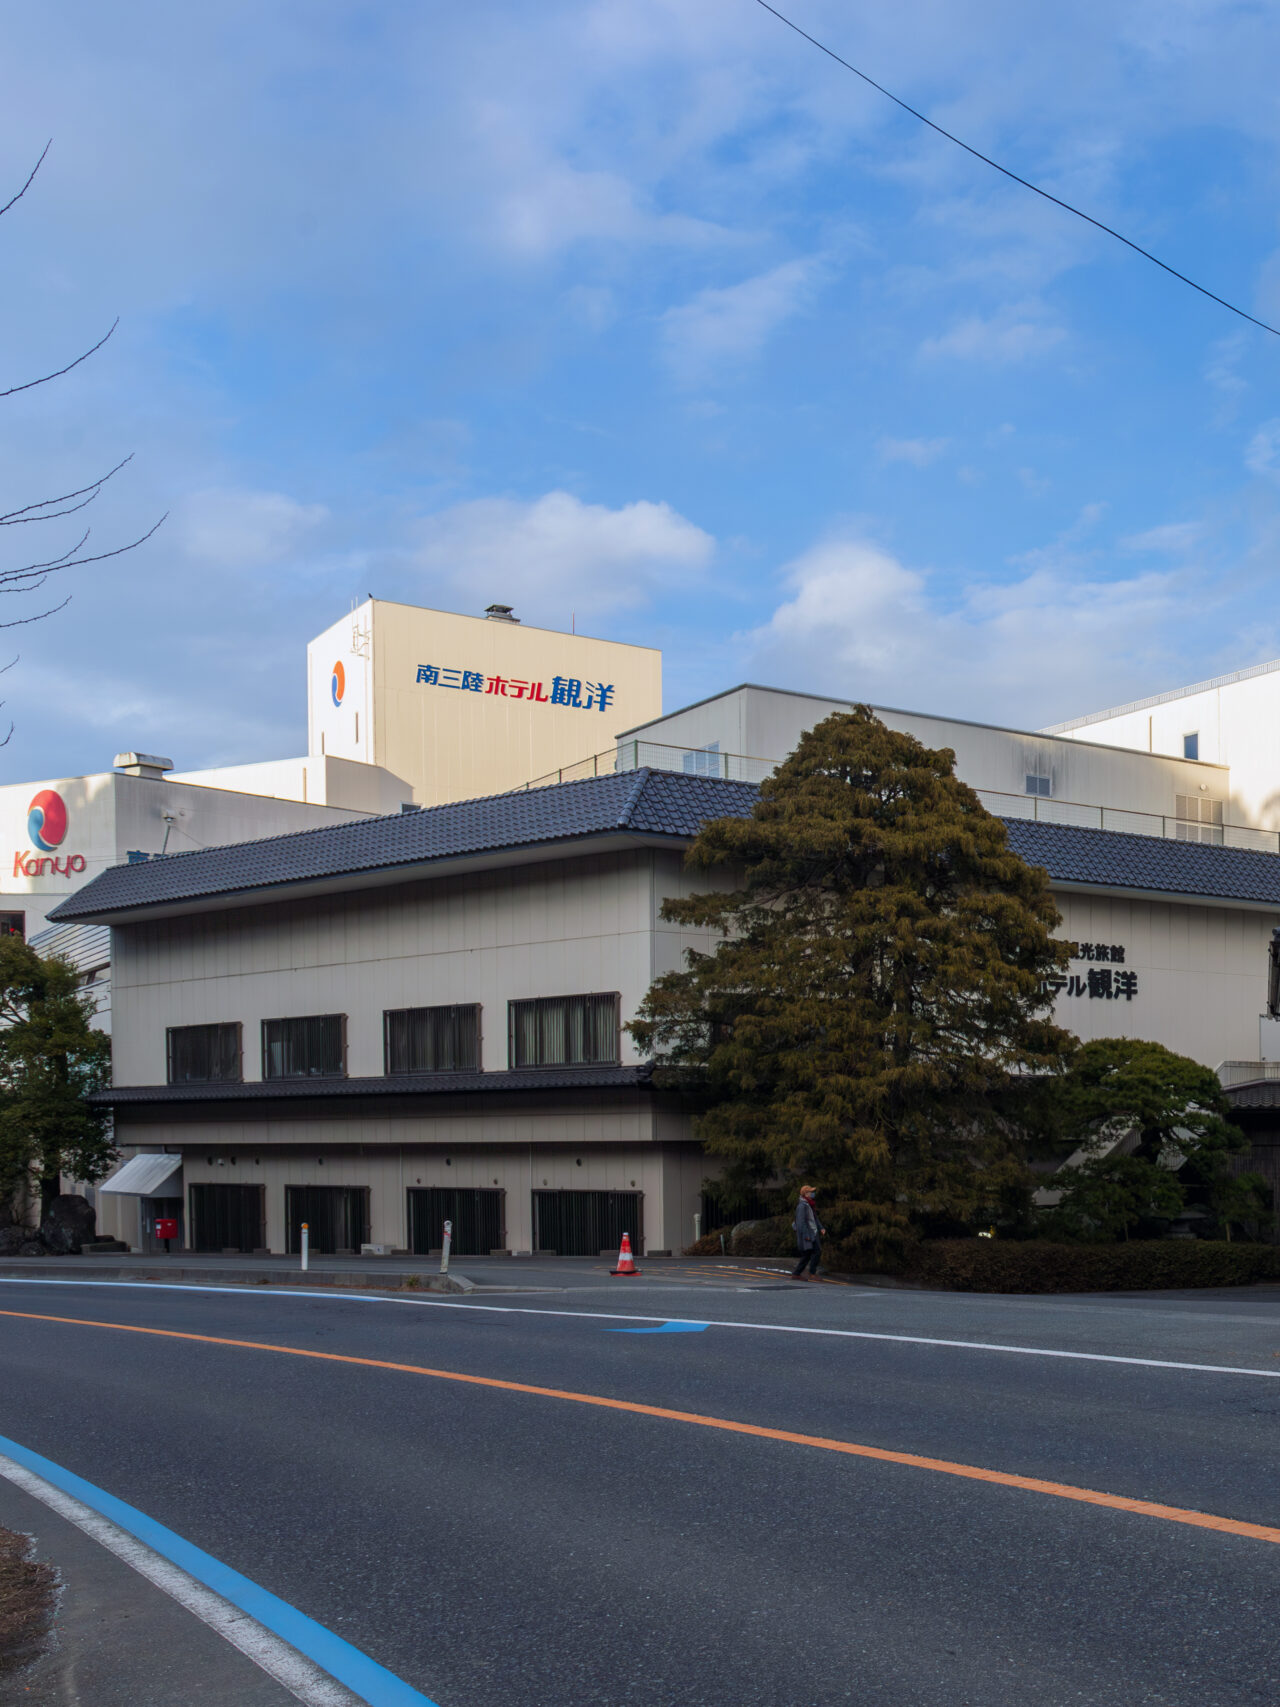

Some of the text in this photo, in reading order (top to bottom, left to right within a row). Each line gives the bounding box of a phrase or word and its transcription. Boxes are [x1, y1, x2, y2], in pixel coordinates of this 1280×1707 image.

[416, 664, 615, 713] 南三陸ホテル観洋
[13, 850, 86, 879] Kanyo
